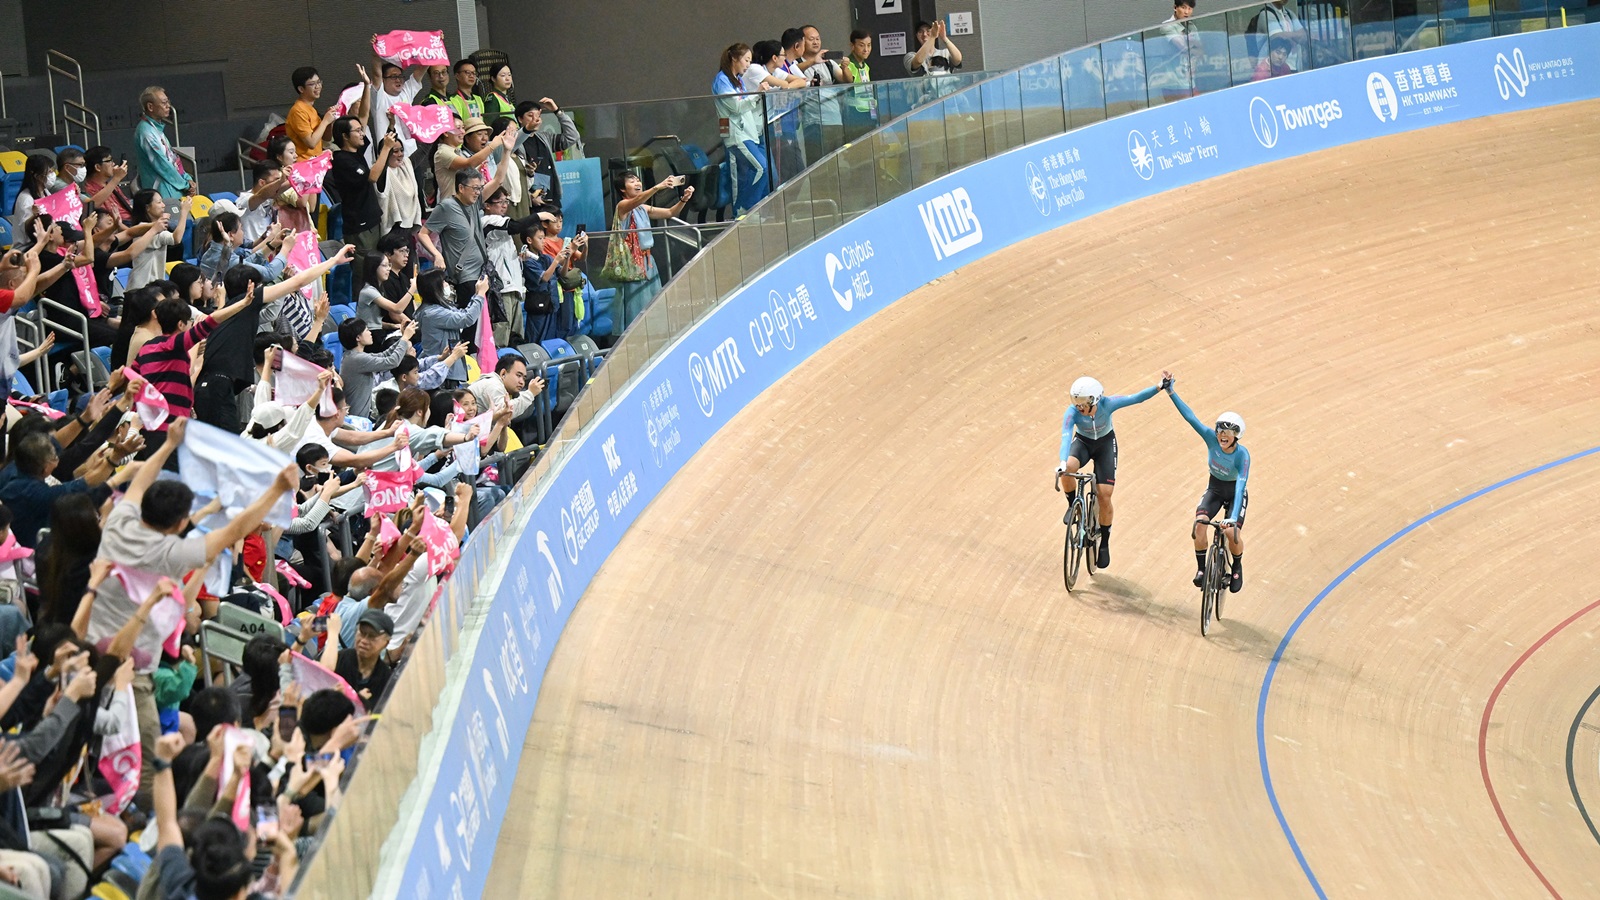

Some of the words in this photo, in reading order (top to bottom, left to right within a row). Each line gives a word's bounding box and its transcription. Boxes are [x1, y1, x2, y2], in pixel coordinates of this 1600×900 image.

[1394, 62, 1453, 92] 香港電車
[1528, 62, 1541, 71] NEW
[1541, 59, 1562, 69] LANTAO
[1562, 57, 1574, 67] BUS
[1401, 95, 1413, 107] HK
[1413, 87, 1458, 104] TRAMWAYS
[1276, 99, 1343, 130] Towngas
[1151, 116, 1212, 149] 天星小輪
[1042, 147, 1081, 172] 香港賽馬會
[1157, 156, 1173, 171] The
[1196, 144, 1219, 160] Ferry
[1048, 175, 1060, 189] The
[1058, 172, 1074, 187] Hong
[1071, 168, 1088, 182] Kong
[1054, 191, 1074, 211] Jockey
[1071, 186, 1085, 202] Club
[918, 187, 983, 262] KMB
[841, 240, 875, 270] Citybus
[851, 270, 873, 301] 城巴
[788, 283, 818, 330] 中電
[749, 311, 774, 357] CLP
[704, 336, 746, 397] MTR
[240, 623, 266, 634] A04
